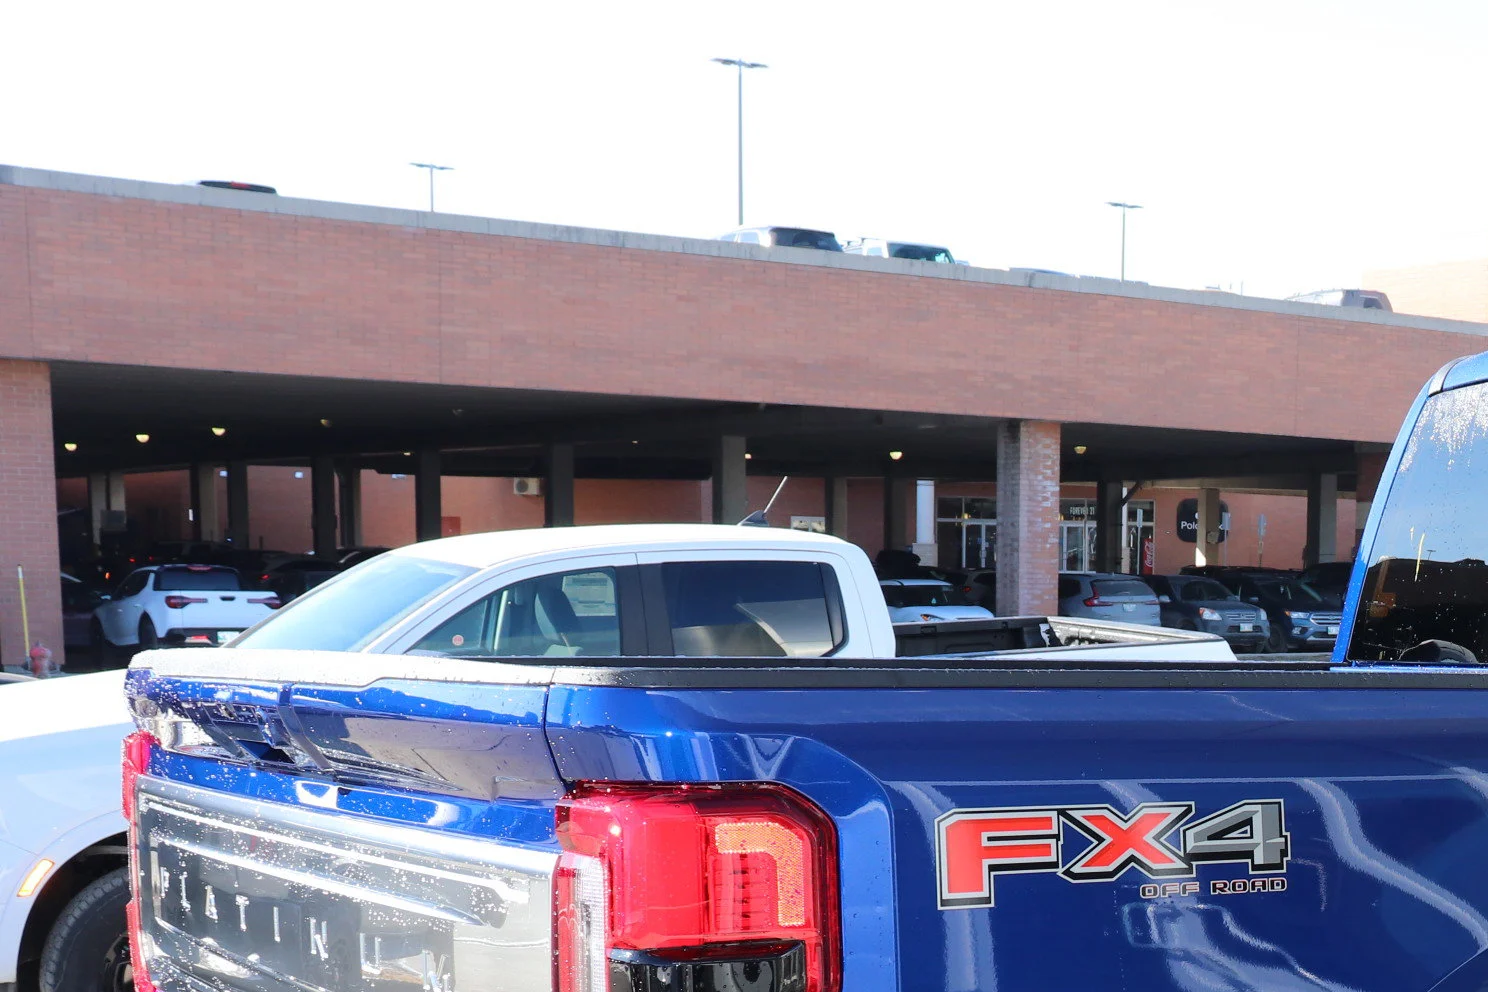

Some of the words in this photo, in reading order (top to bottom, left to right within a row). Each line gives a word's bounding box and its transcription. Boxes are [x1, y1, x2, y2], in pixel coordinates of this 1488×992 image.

[934, 798, 1291, 911] FX4
[1139, 881, 1200, 899] OFF
[1210, 877, 1288, 896] ROAD
